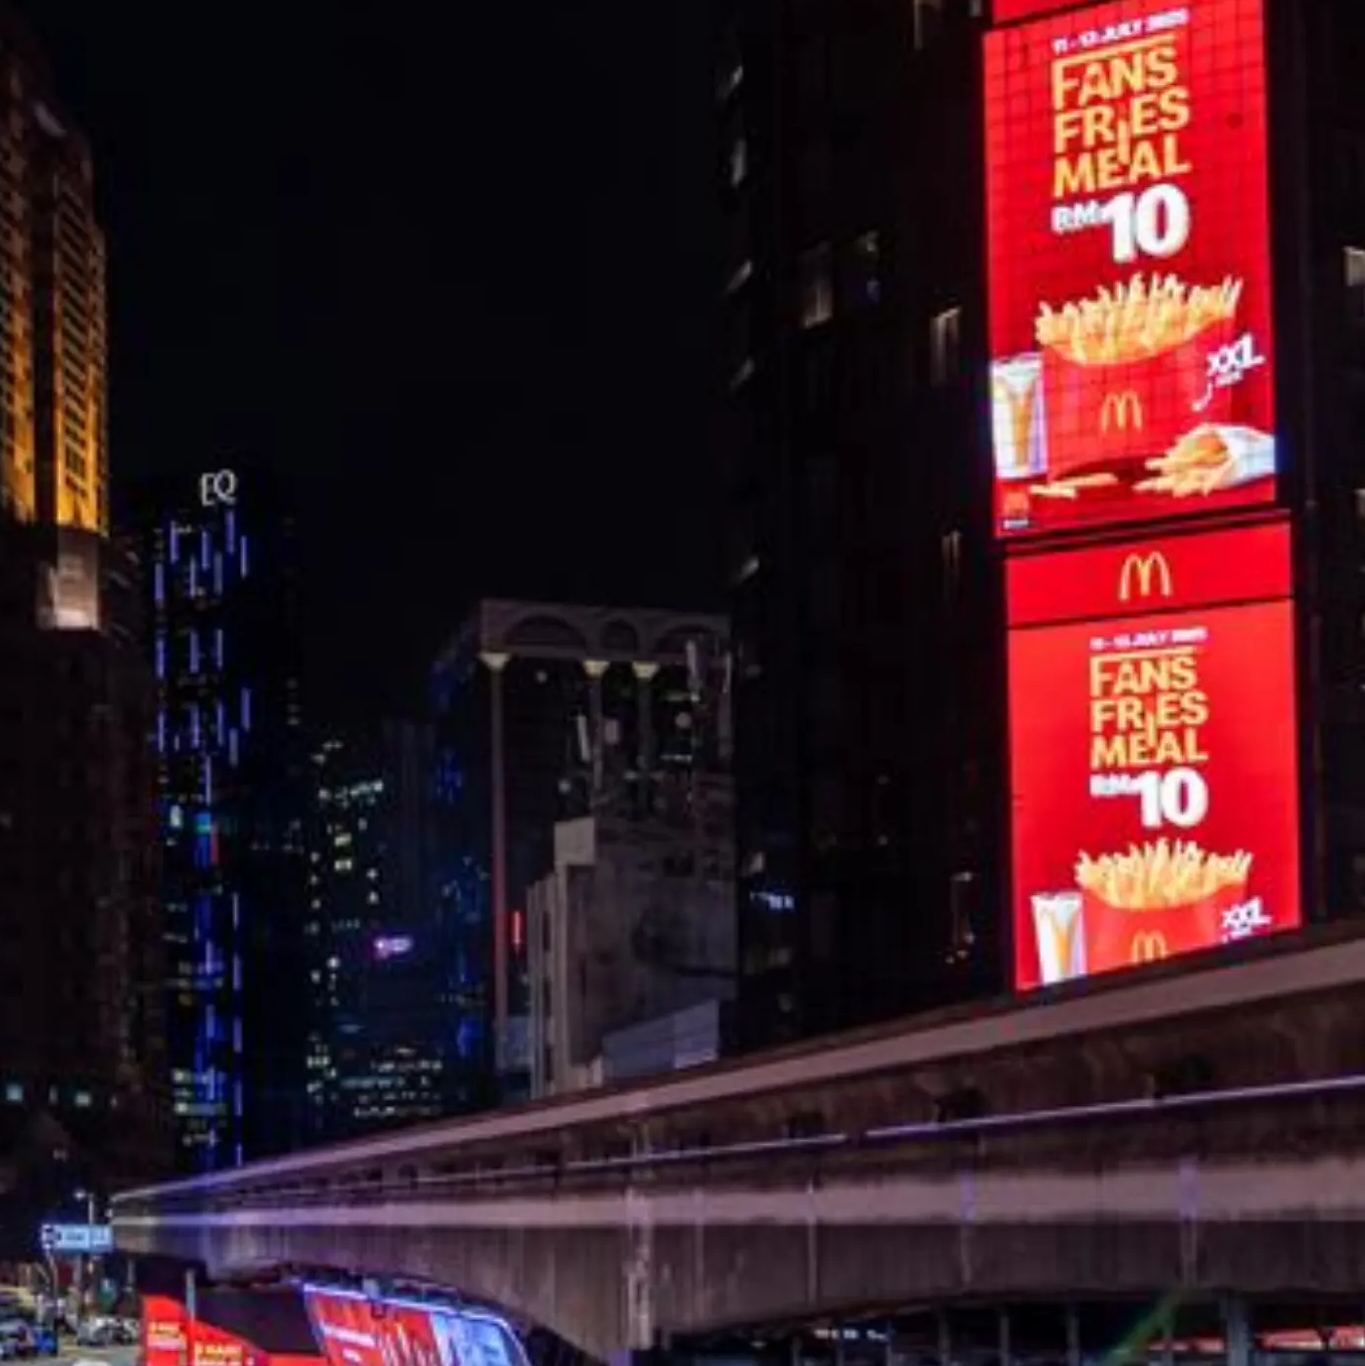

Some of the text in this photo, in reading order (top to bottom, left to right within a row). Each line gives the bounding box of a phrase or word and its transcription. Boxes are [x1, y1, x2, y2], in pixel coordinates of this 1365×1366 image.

[1052, 34, 1178, 112] FANS
[1054, 87, 1191, 159] FRIES
[1054, 135, 1192, 199] MEAL
[200, 468, 238, 507] EQ
[1089, 647, 1197, 698] FANS
[1091, 691, 1209, 740] FRIES
[1091, 731, 1209, 768] MEAL
